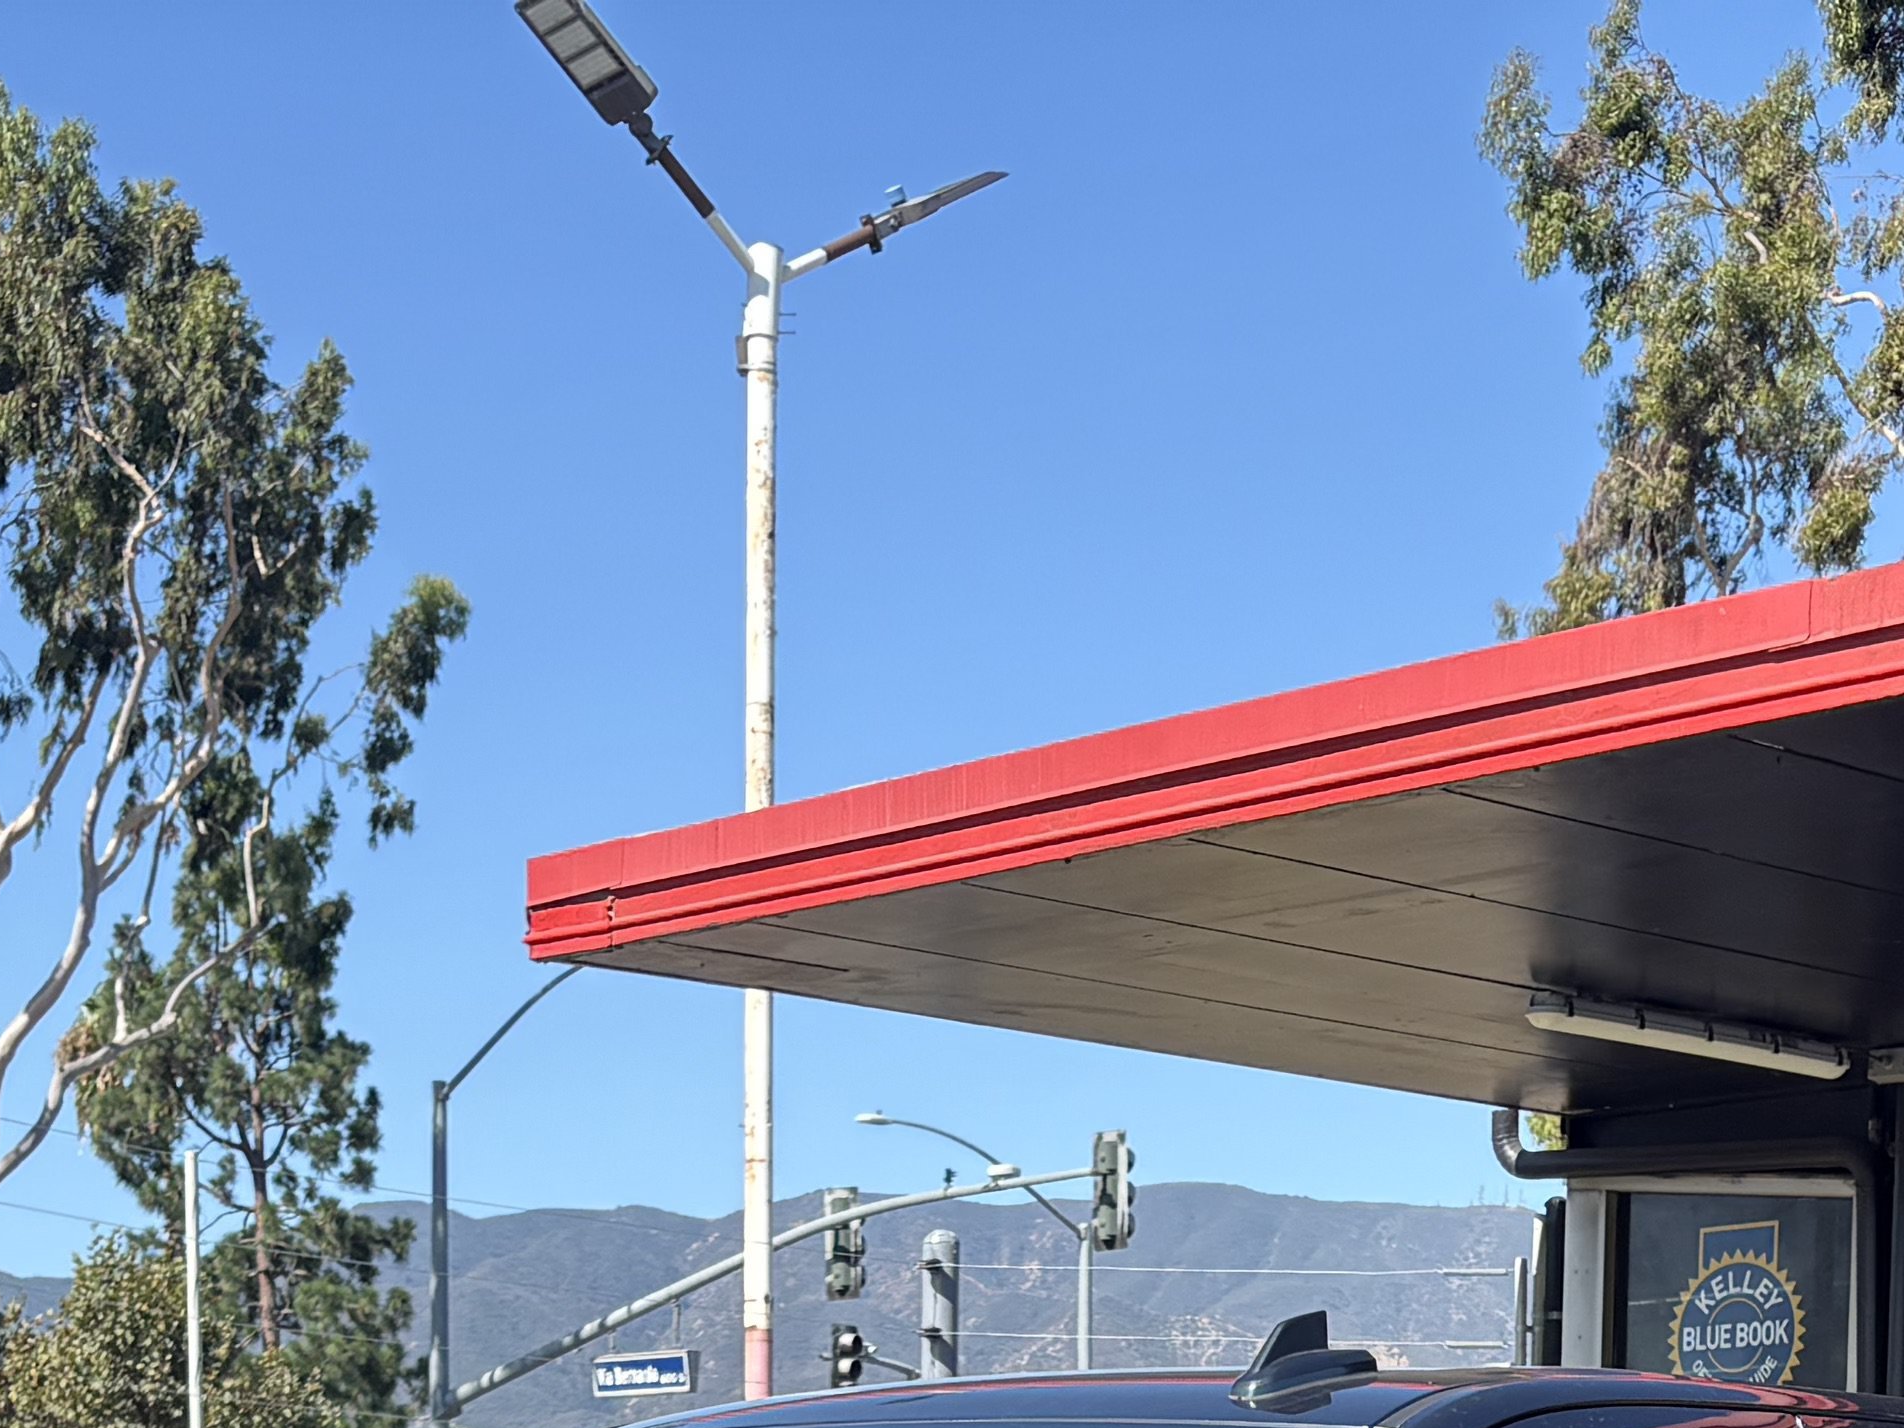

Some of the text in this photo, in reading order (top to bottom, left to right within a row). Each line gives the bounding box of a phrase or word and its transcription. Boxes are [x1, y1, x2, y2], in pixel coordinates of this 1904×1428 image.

[1695, 1270, 1784, 1315] KELLEY
[1682, 1318, 1790, 1353] BLUE BOOK
